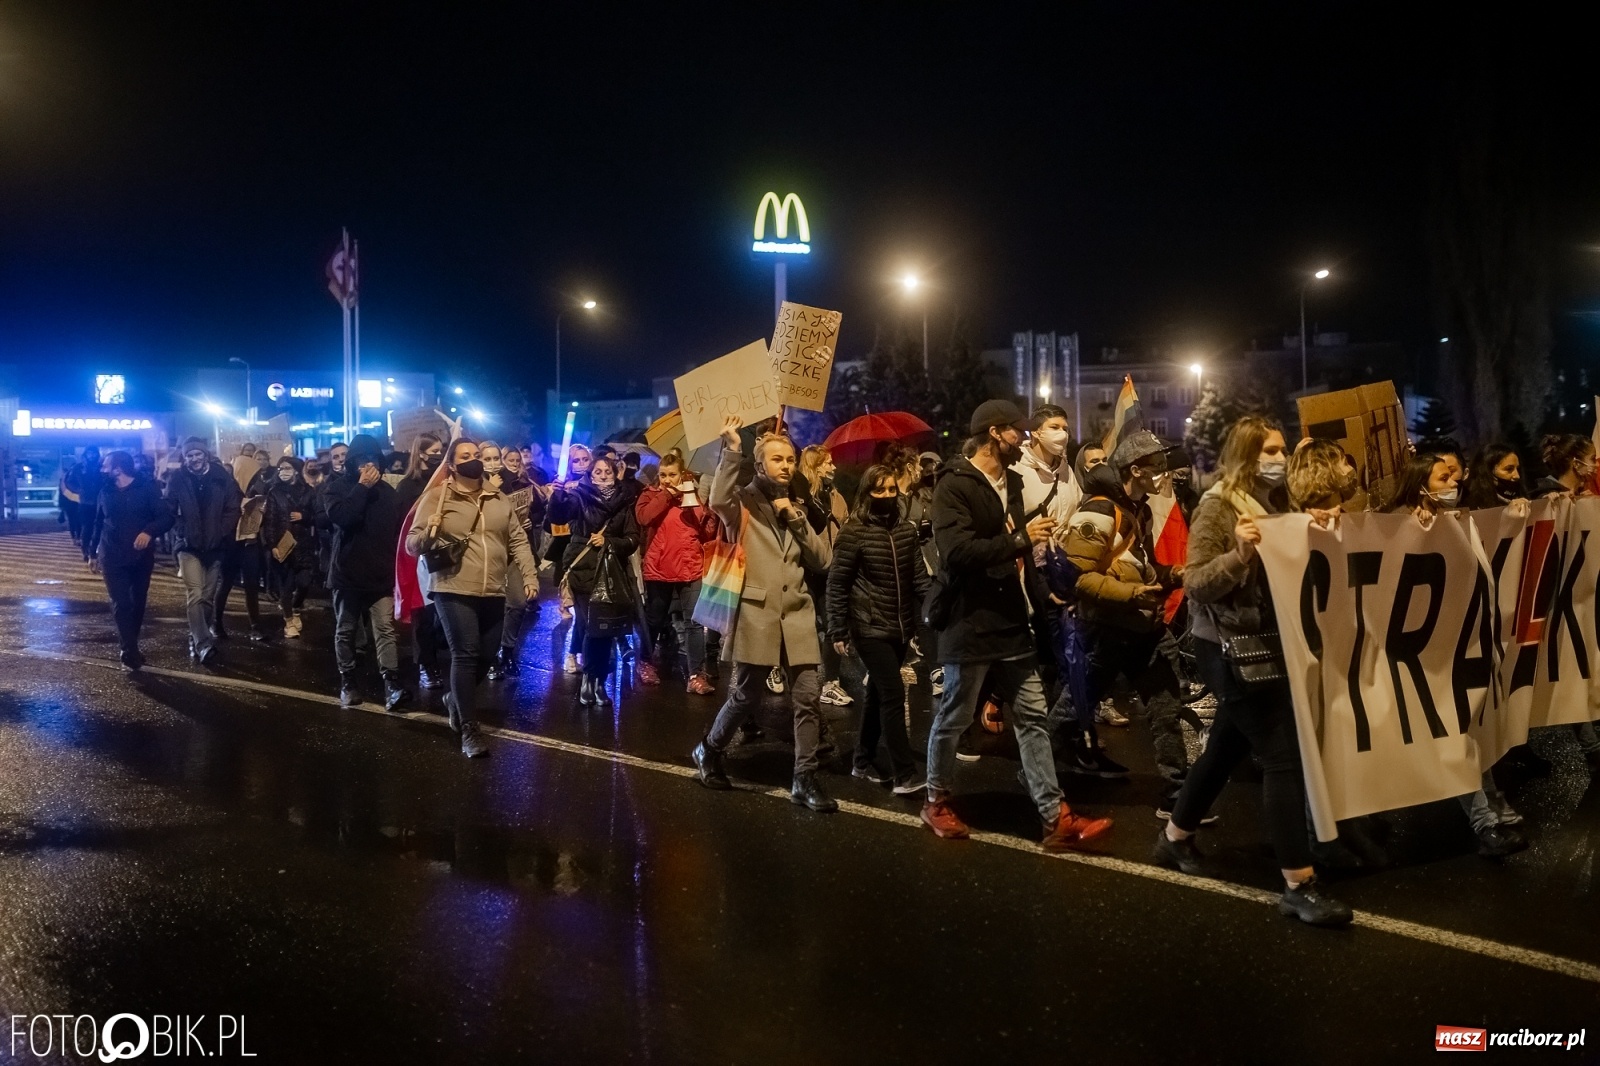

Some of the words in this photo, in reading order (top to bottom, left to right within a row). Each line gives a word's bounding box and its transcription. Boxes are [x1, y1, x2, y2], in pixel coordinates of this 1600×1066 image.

[771, 357, 822, 381] ACZKĘ
[682, 384, 722, 414] GIRL
[714, 380, 777, 419] POWER
[31, 417, 153, 430] RESTAURACJA
